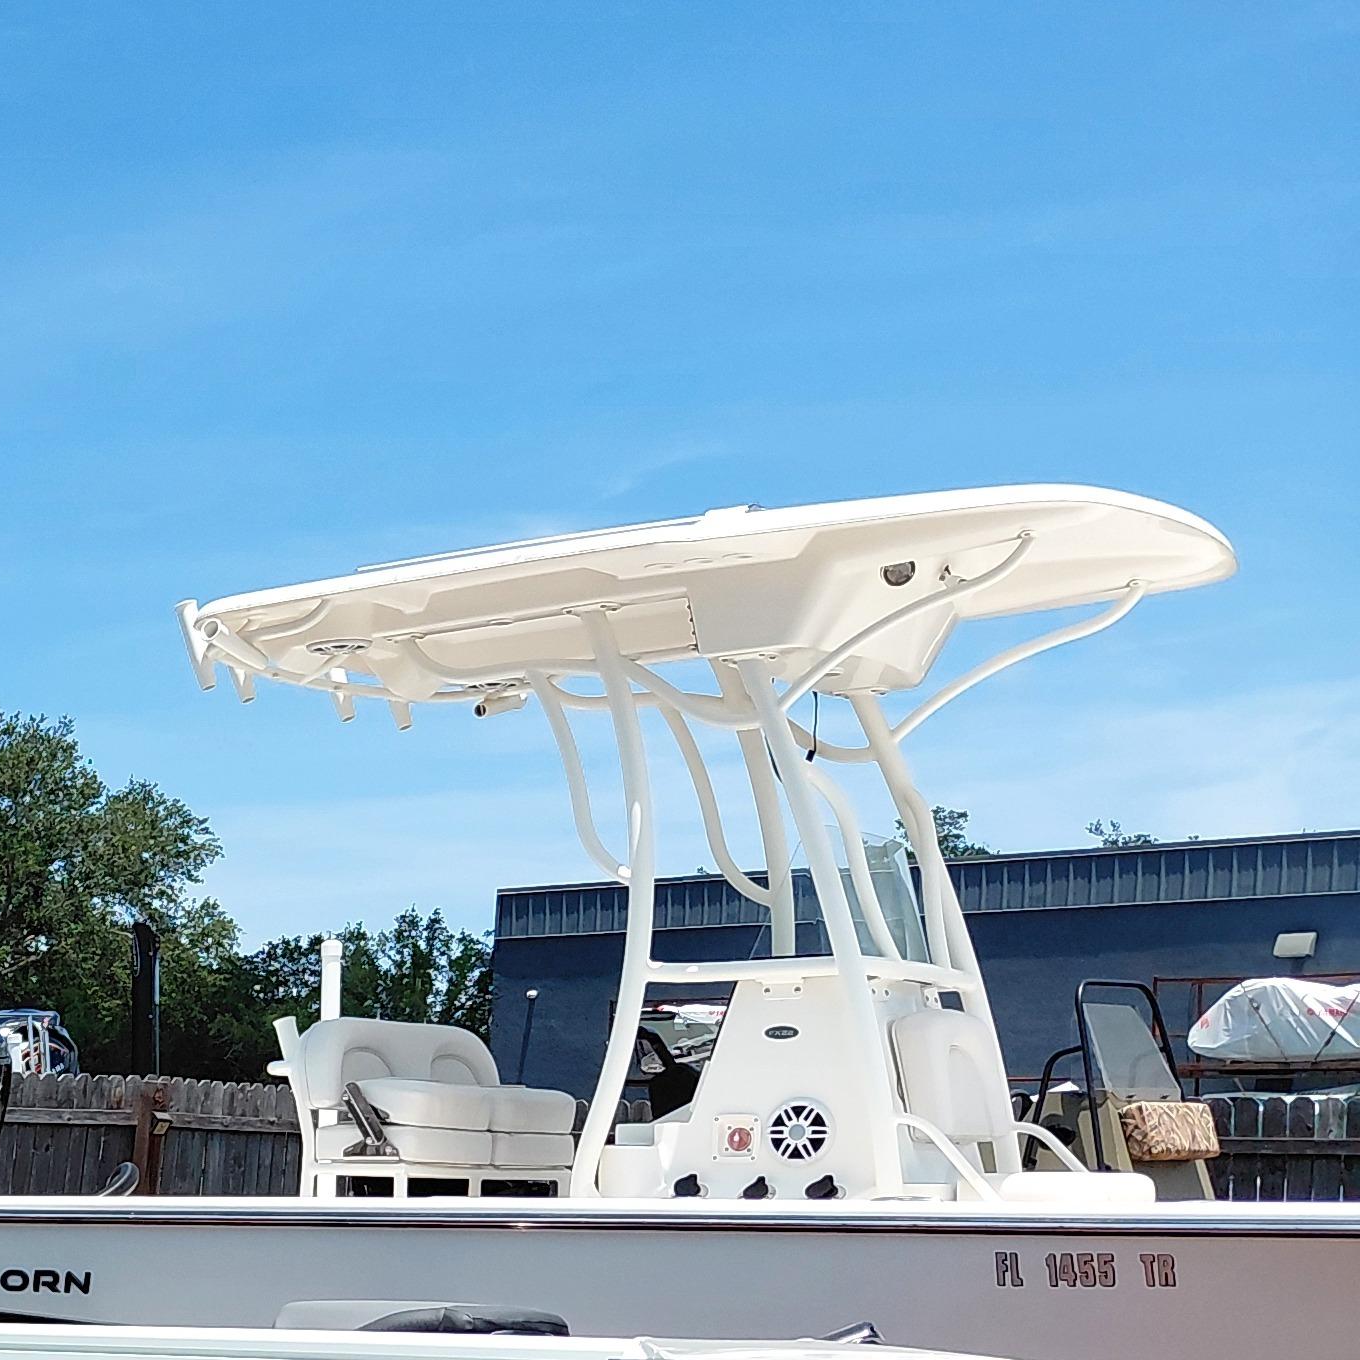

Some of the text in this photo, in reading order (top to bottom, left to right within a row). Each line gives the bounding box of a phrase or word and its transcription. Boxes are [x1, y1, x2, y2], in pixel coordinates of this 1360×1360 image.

[995, 1251, 1177, 1288] FL 1455 TR
